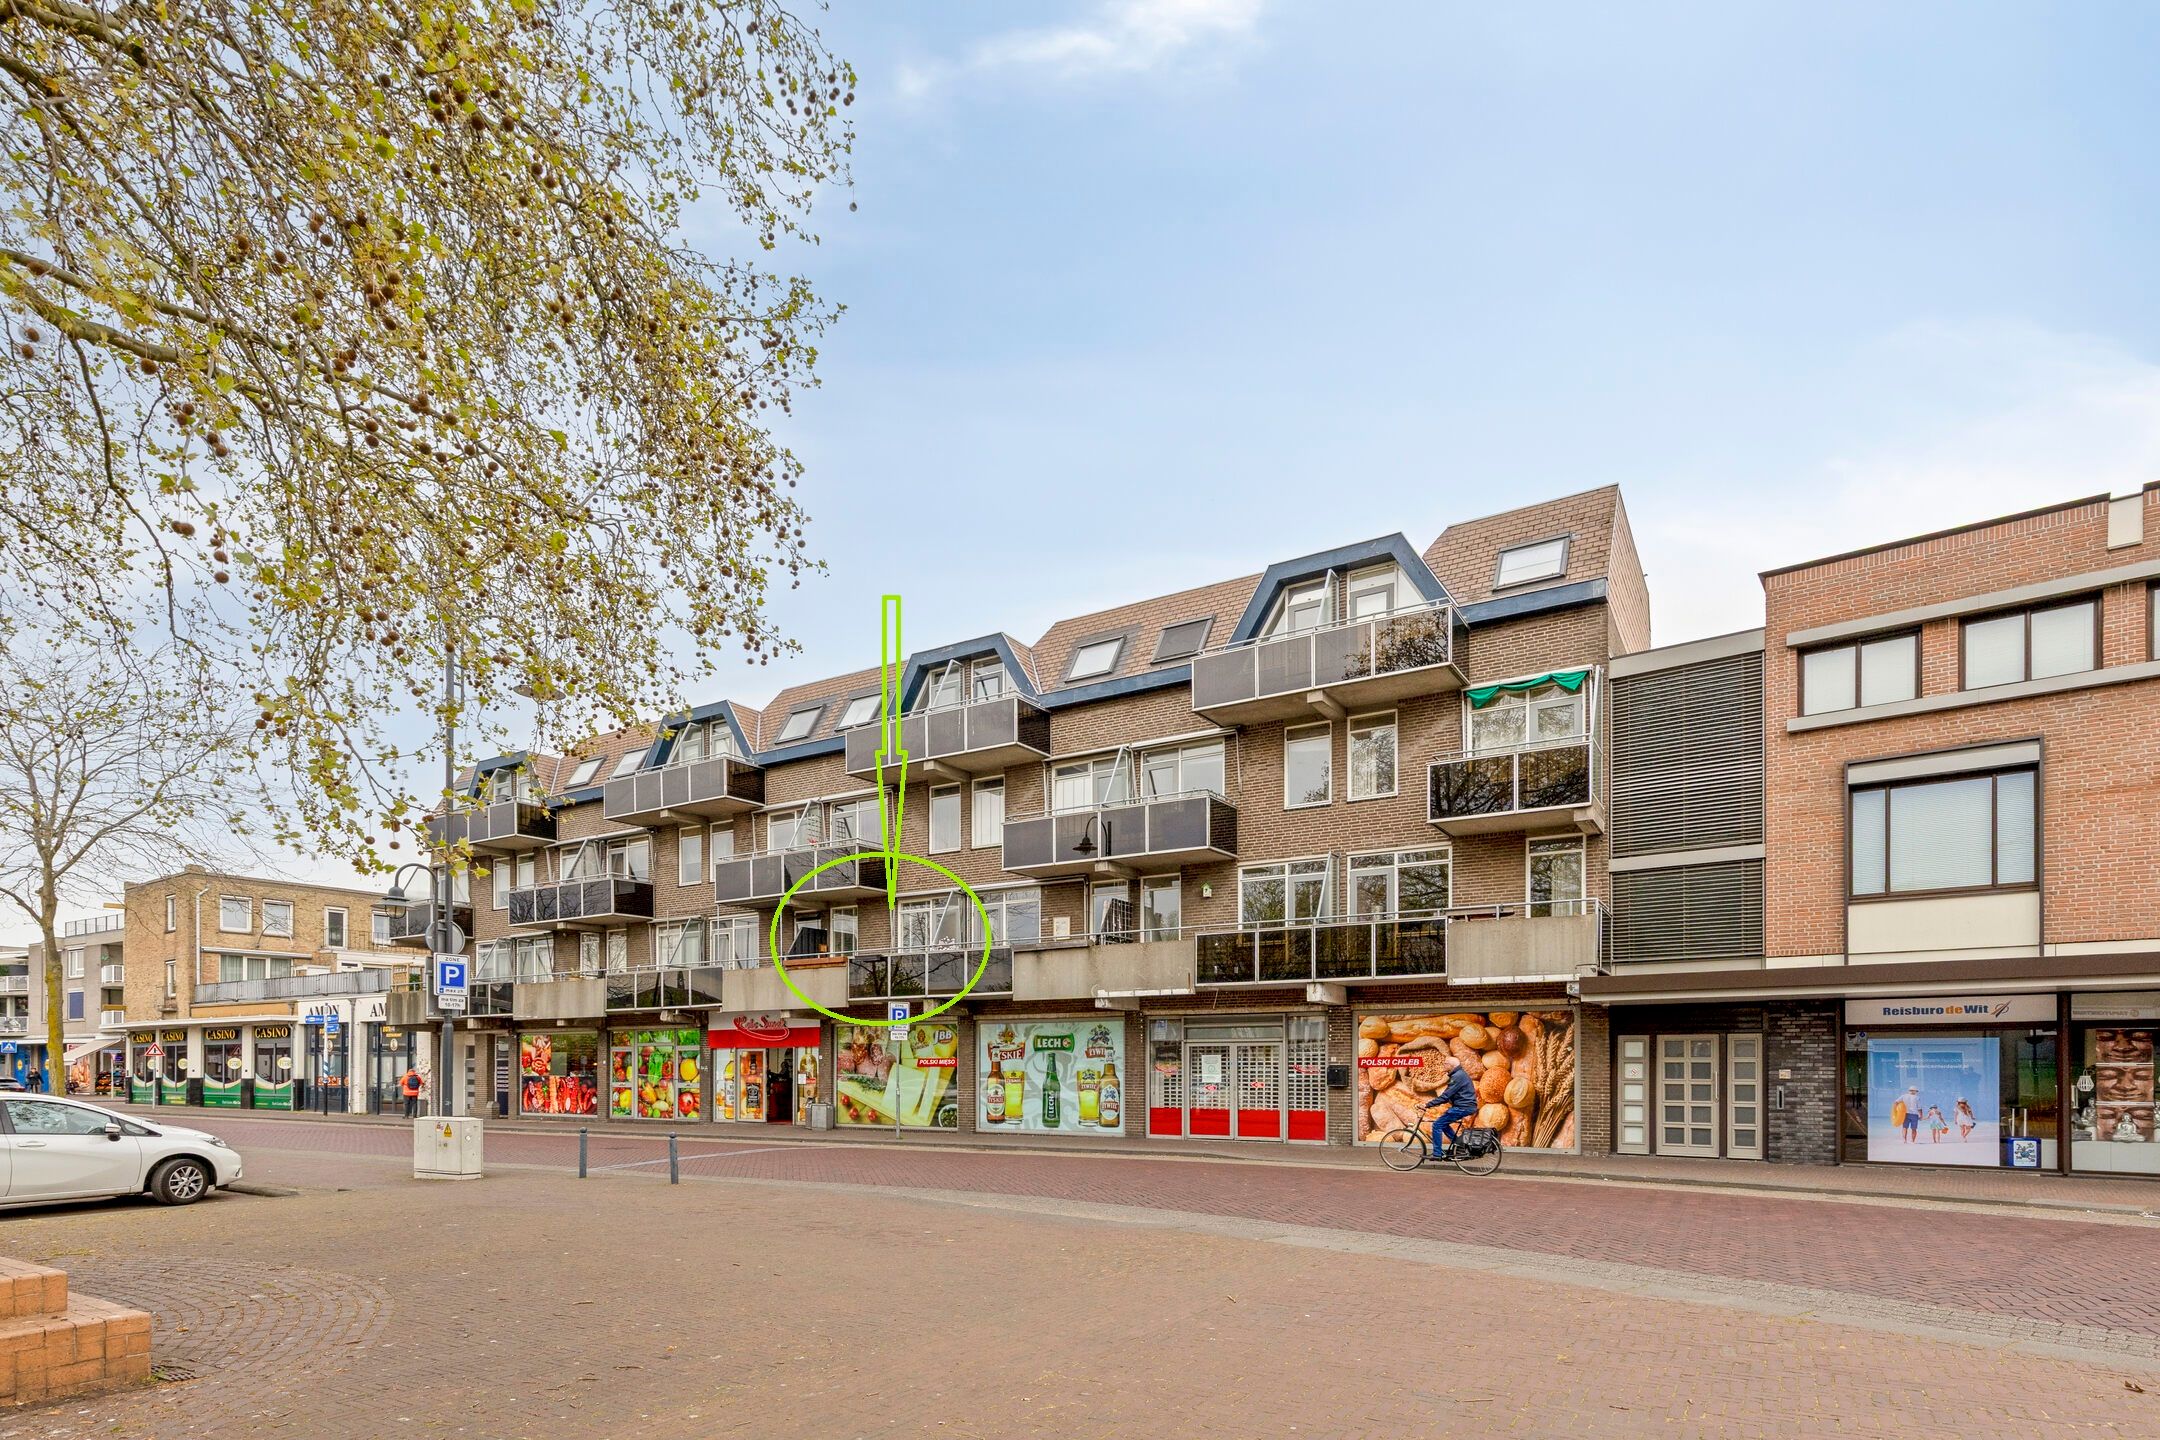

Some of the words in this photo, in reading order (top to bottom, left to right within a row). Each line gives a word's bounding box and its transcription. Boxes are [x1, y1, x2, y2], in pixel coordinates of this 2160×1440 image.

[445, 966, 460, 985] P
[895, 1010, 904, 1021] P
[1882, 1006, 1944, 1016] Reisburo
[1945, 1005, 1963, 1015] de
[1964, 1004, 1989, 1014] Wit
[132, 1031, 153, 1043] CASINO
[162, 1031, 184, 1042] CASINO
[205, 1028, 236, 1040] CASINO
[255, 1026, 288, 1039] CASINO
[933, 1029, 952, 1045] JBB
[1037, 1038, 1061, 1048] LECH
[1361, 1058, 1390, 1066] POLSKI
[1391, 1058, 1420, 1066] CHLEB
[1048, 1095, 1056, 1114] LECH
